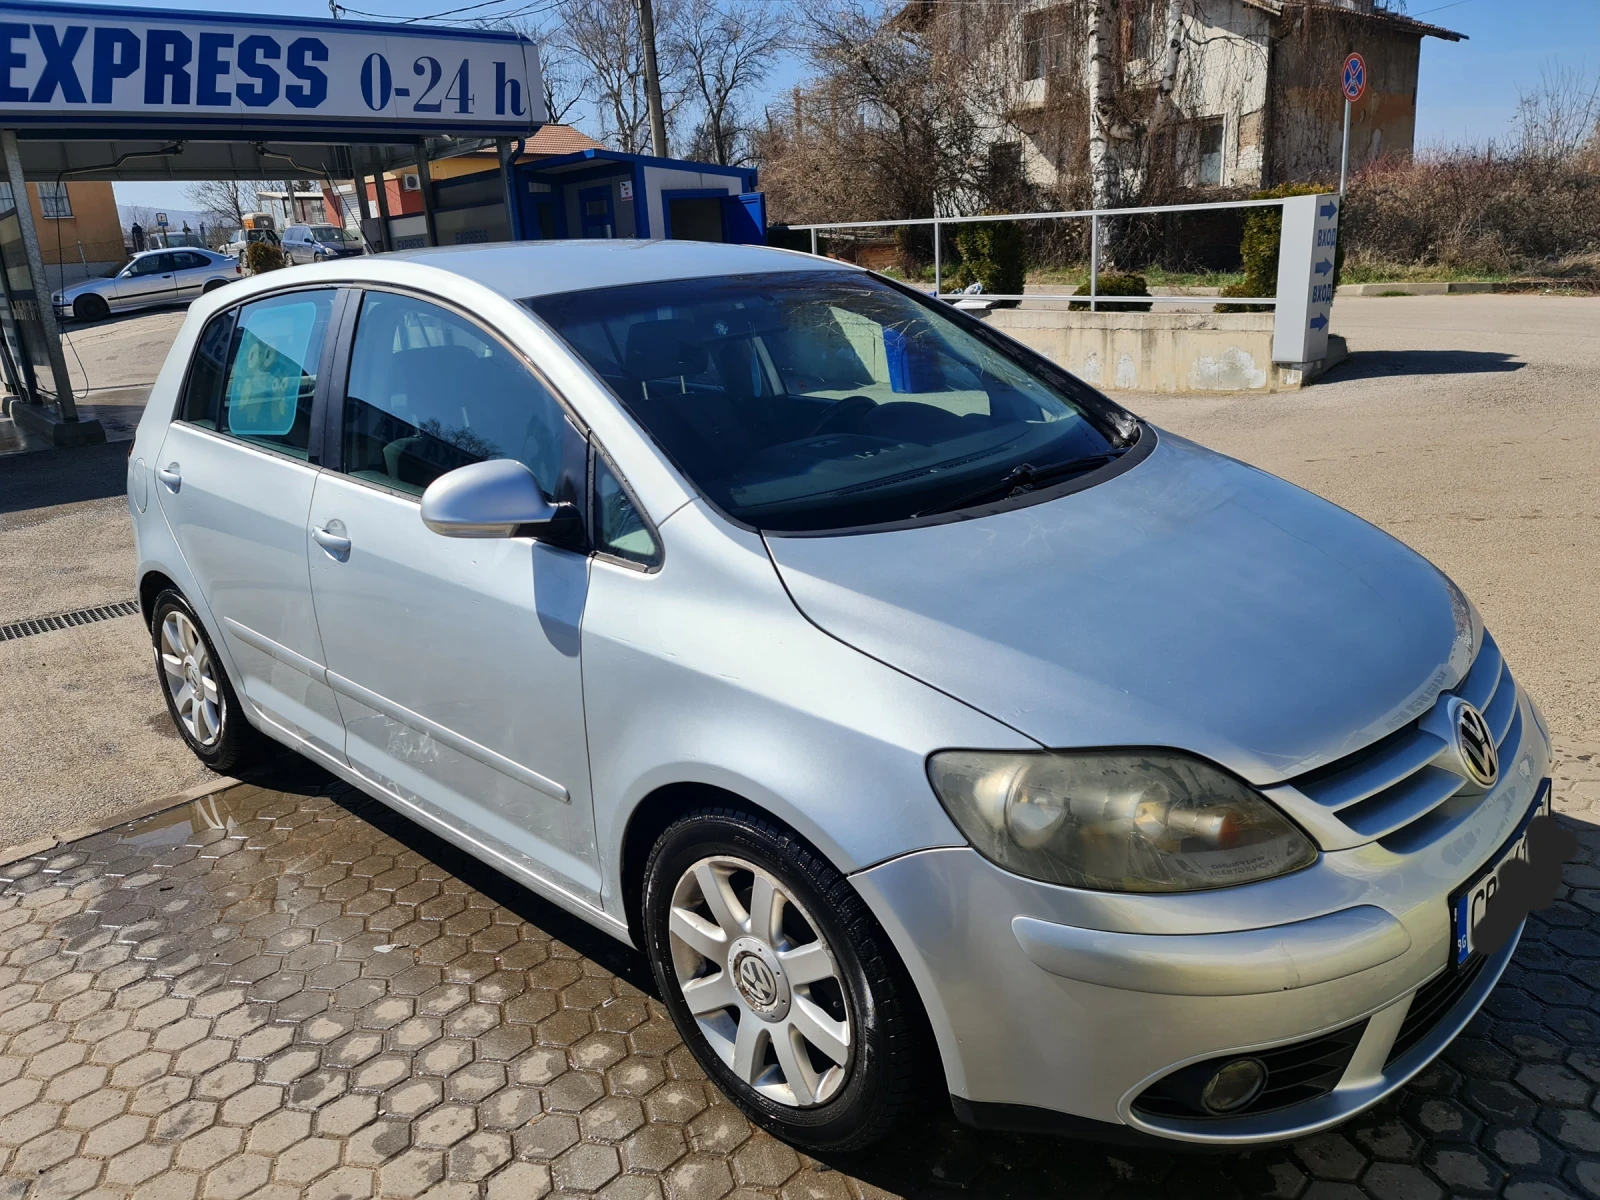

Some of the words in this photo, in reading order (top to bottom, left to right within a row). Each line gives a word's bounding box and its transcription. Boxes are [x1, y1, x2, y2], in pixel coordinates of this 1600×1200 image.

[0, 23, 329, 109] EXPRESS
[360, 52, 475, 115] 0-24
[492, 61, 527, 117] h
[456, 229, 489, 245] EXPRESS
[1317, 227, 1337, 249] ВХОД
[1312, 283, 1332, 305] ВХОД
